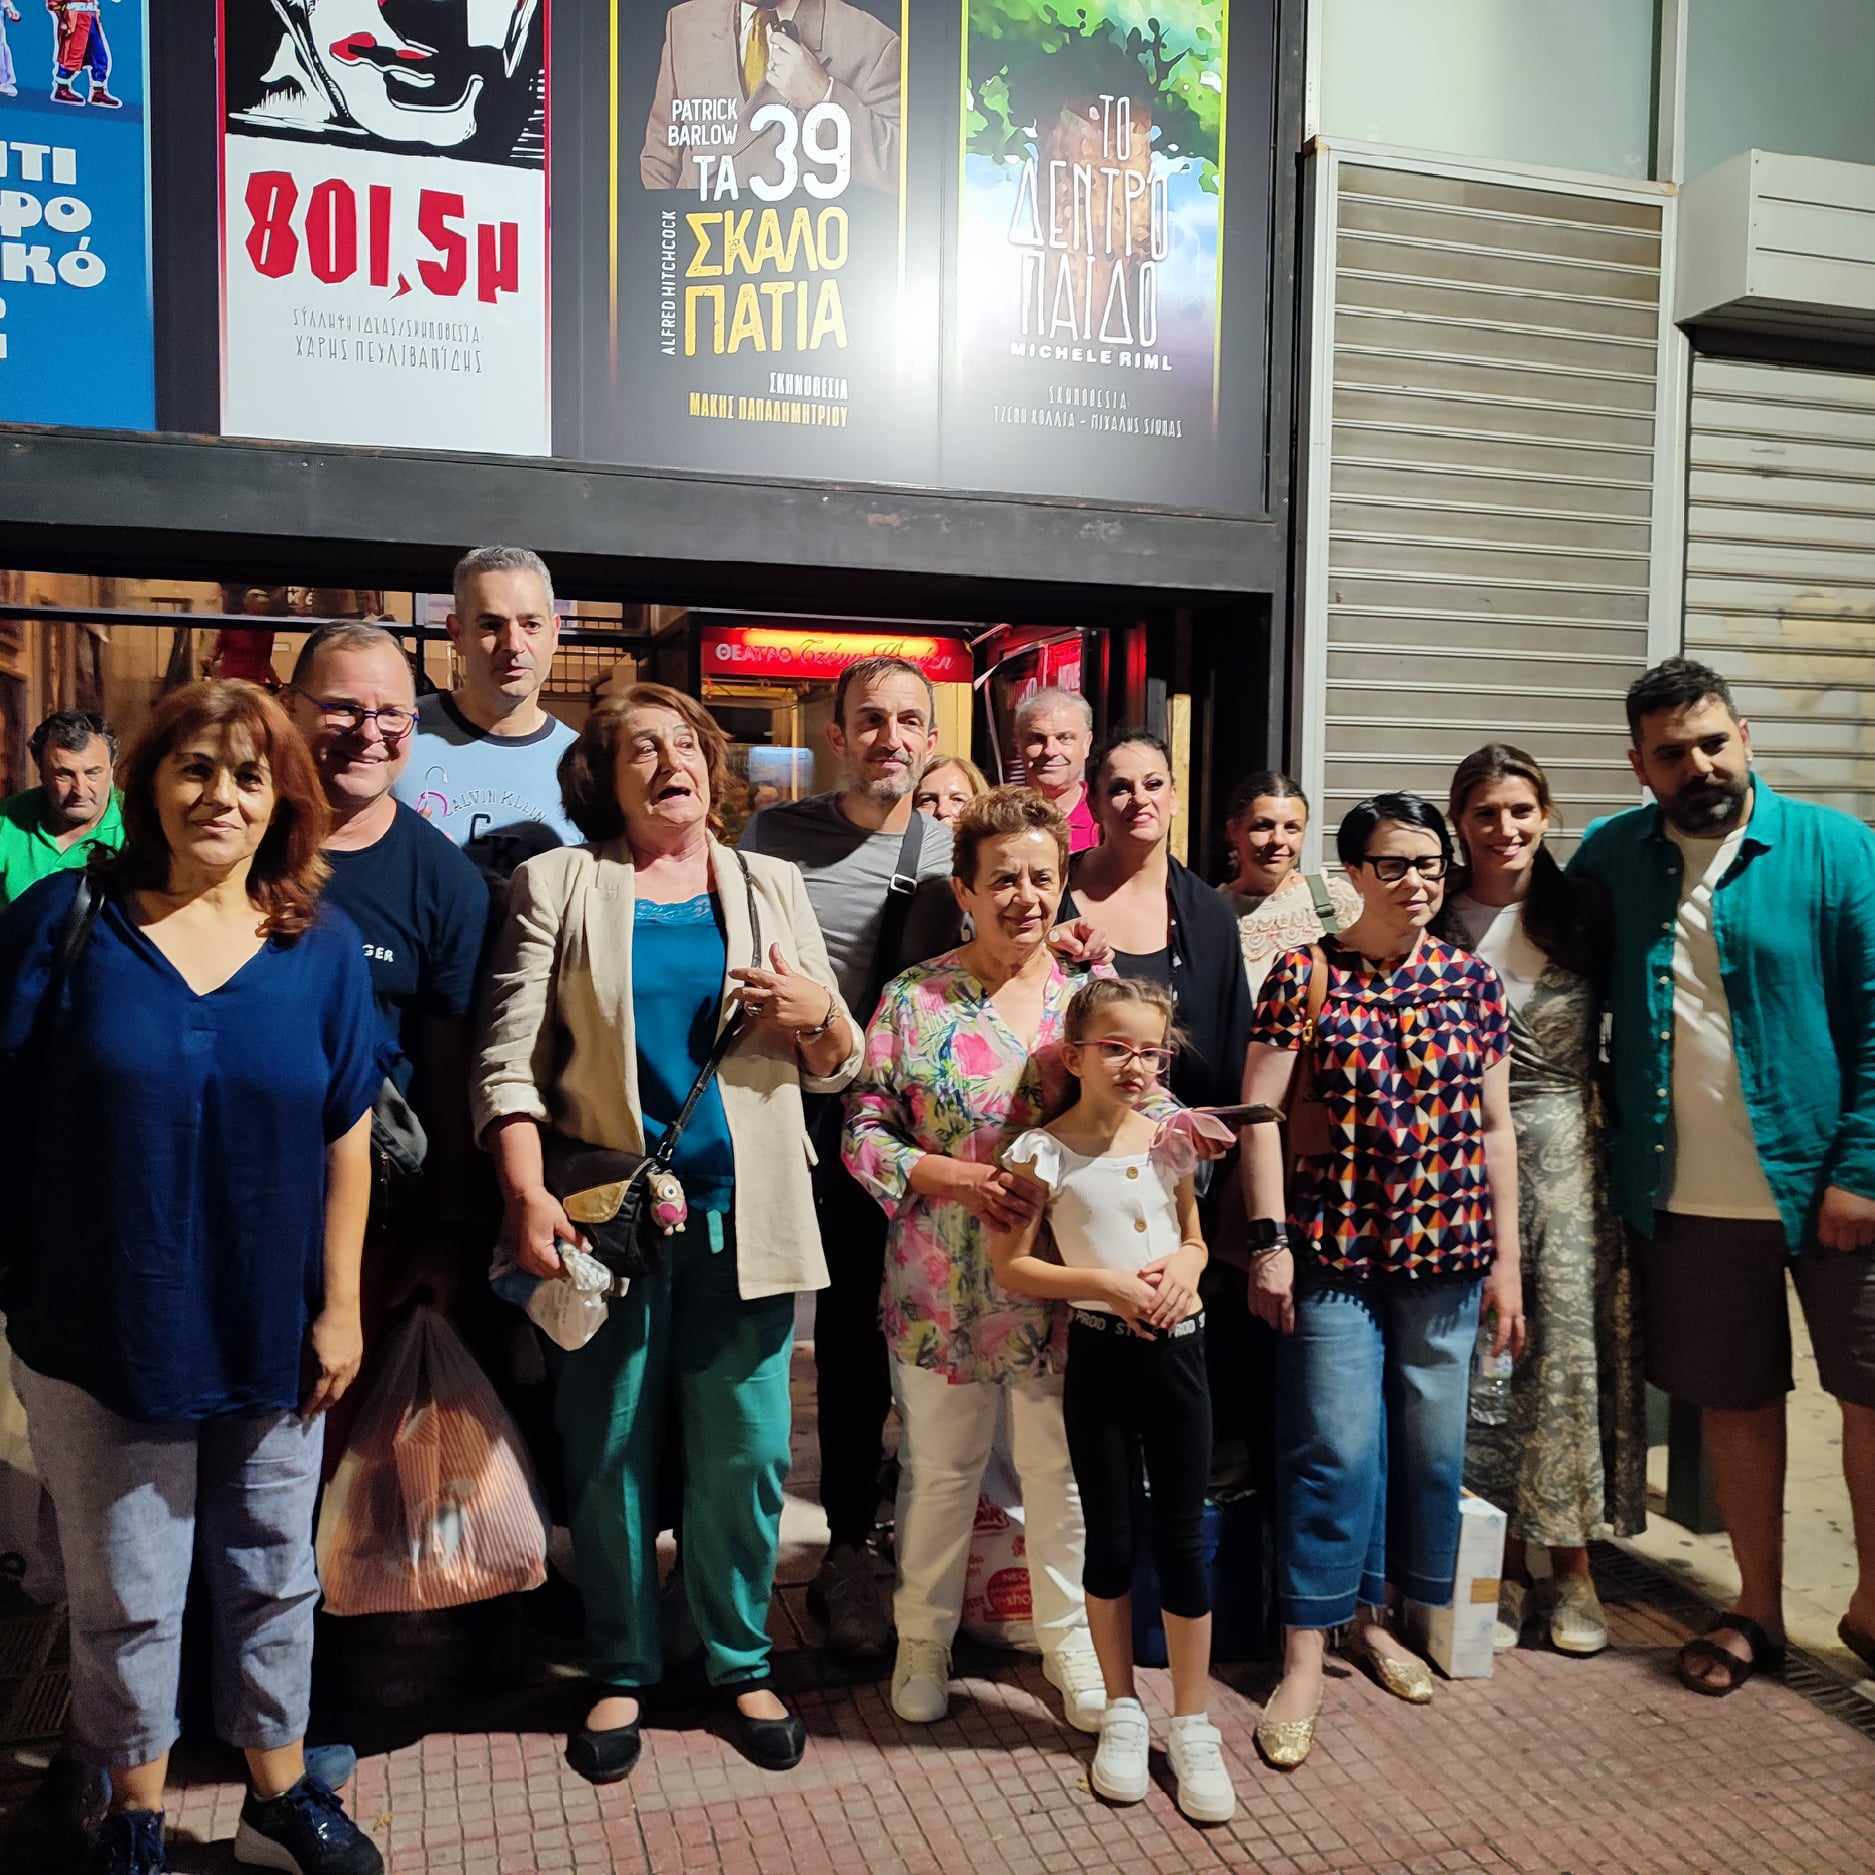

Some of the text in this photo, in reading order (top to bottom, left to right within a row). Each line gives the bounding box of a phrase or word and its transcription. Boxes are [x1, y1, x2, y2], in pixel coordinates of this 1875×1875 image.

[668, 123, 738, 147] BARLOW
[672, 98, 738, 121] PATRICK
[1099, 94, 1130, 161] ΤΟ
[692, 101, 851, 201] ΤΑ 39
[685, 206, 849, 278] ΣΚΑΛΟ
[660, 210, 677, 356] ALFRED HITCHCOCK
[1020, 249, 1157, 348] ΠΑΙΔΟ
[685, 278, 849, 357] ΠΑΤΙΑ
[1010, 341, 1172, 371] MICHELE RIML
[689, 391, 849, 428] ΜΑΚΗΣ ΠΑΠΑΔΗΜΗΤΡΙΟΥ
[769, 371, 849, 400] ΣΚΗΝΟΘΕΣΙΑ
[715, 643, 792, 663] ΘΕΑΤΡΟ
